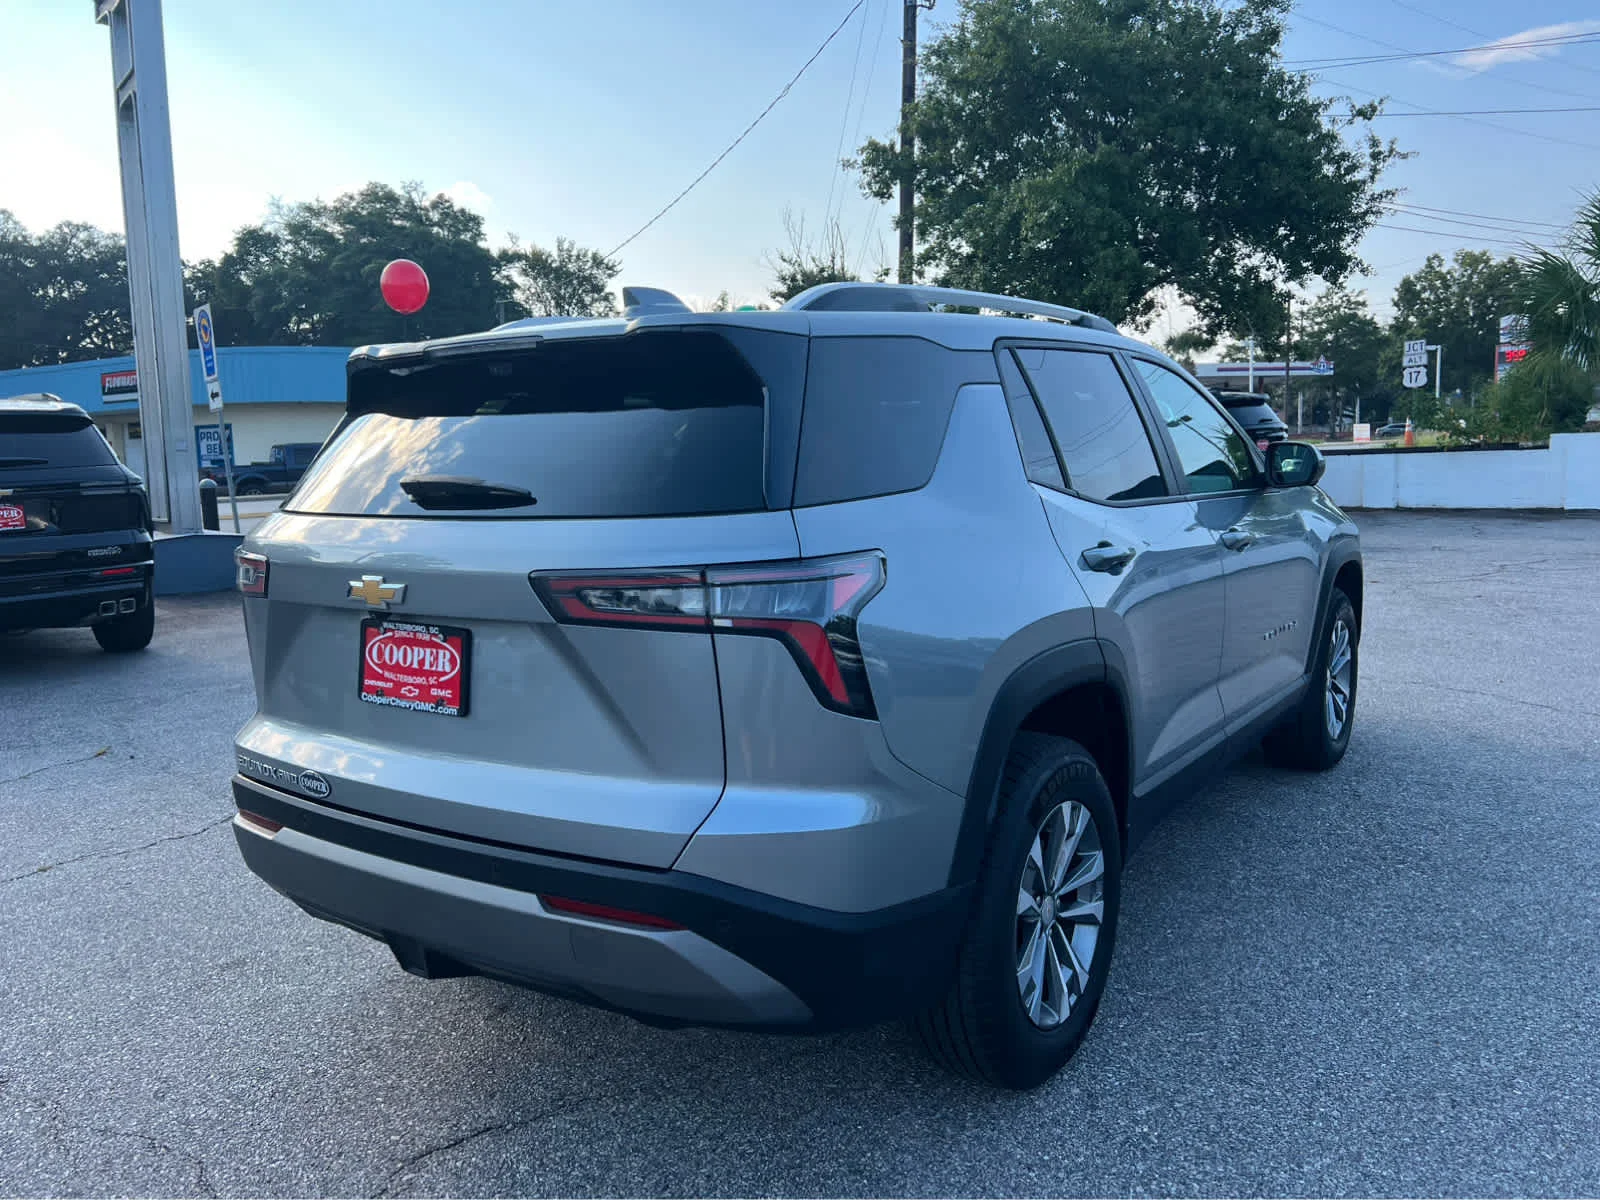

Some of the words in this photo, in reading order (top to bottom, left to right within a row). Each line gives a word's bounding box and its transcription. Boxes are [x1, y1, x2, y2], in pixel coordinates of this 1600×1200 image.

[1406, 341, 1425, 352] JCT
[1408, 356, 1423, 364] ALT
[1408, 370, 1421, 384] 17
[429, 626, 439, 634] SC
[371, 641, 452, 673] COOPER
[428, 677, 438, 685] SC
[430, 687, 453, 698] GMC
[361, 692, 458, 716] CooperChevyGMC.com
[304, 777, 327, 793] COOPER
